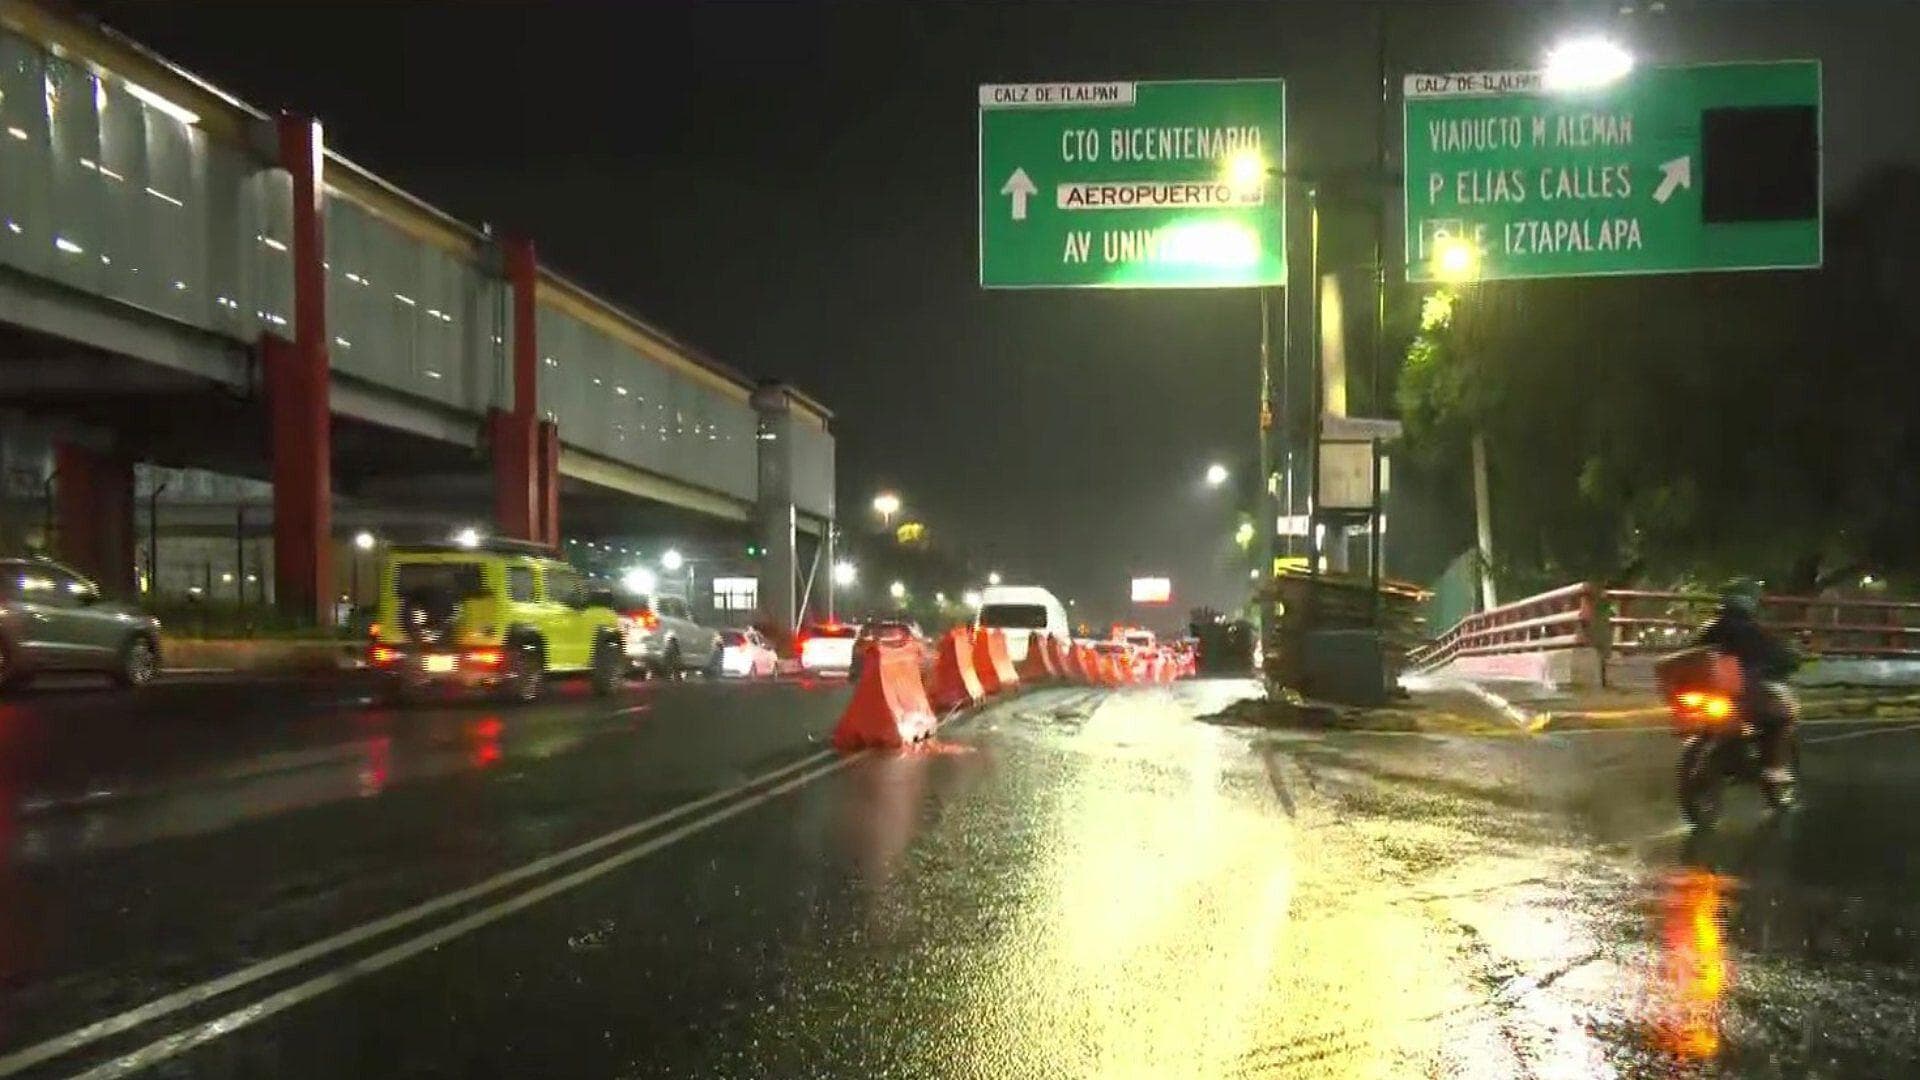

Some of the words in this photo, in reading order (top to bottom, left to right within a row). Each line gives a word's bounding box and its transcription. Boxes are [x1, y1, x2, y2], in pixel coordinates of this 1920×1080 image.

[994, 87, 1027, 103] CALZ
[1036, 87, 1050, 101] DE
[1061, 86, 1119, 100] TLALPAN
[1062, 128, 1099, 162] CTO
[1429, 116, 1520, 152] VIADUCTO
[1532, 115, 1546, 147] M
[1556, 114, 1633, 147] ALEMAN
[1067, 184, 1232, 206] AEROPUERTO
[1430, 174, 1444, 205] P
[1458, 170, 1526, 204] ELIAS
[1540, 166, 1632, 200] CALLES
[1063, 231, 1091, 263] AV
[1505, 218, 1642, 255] IZTAPALAPA
